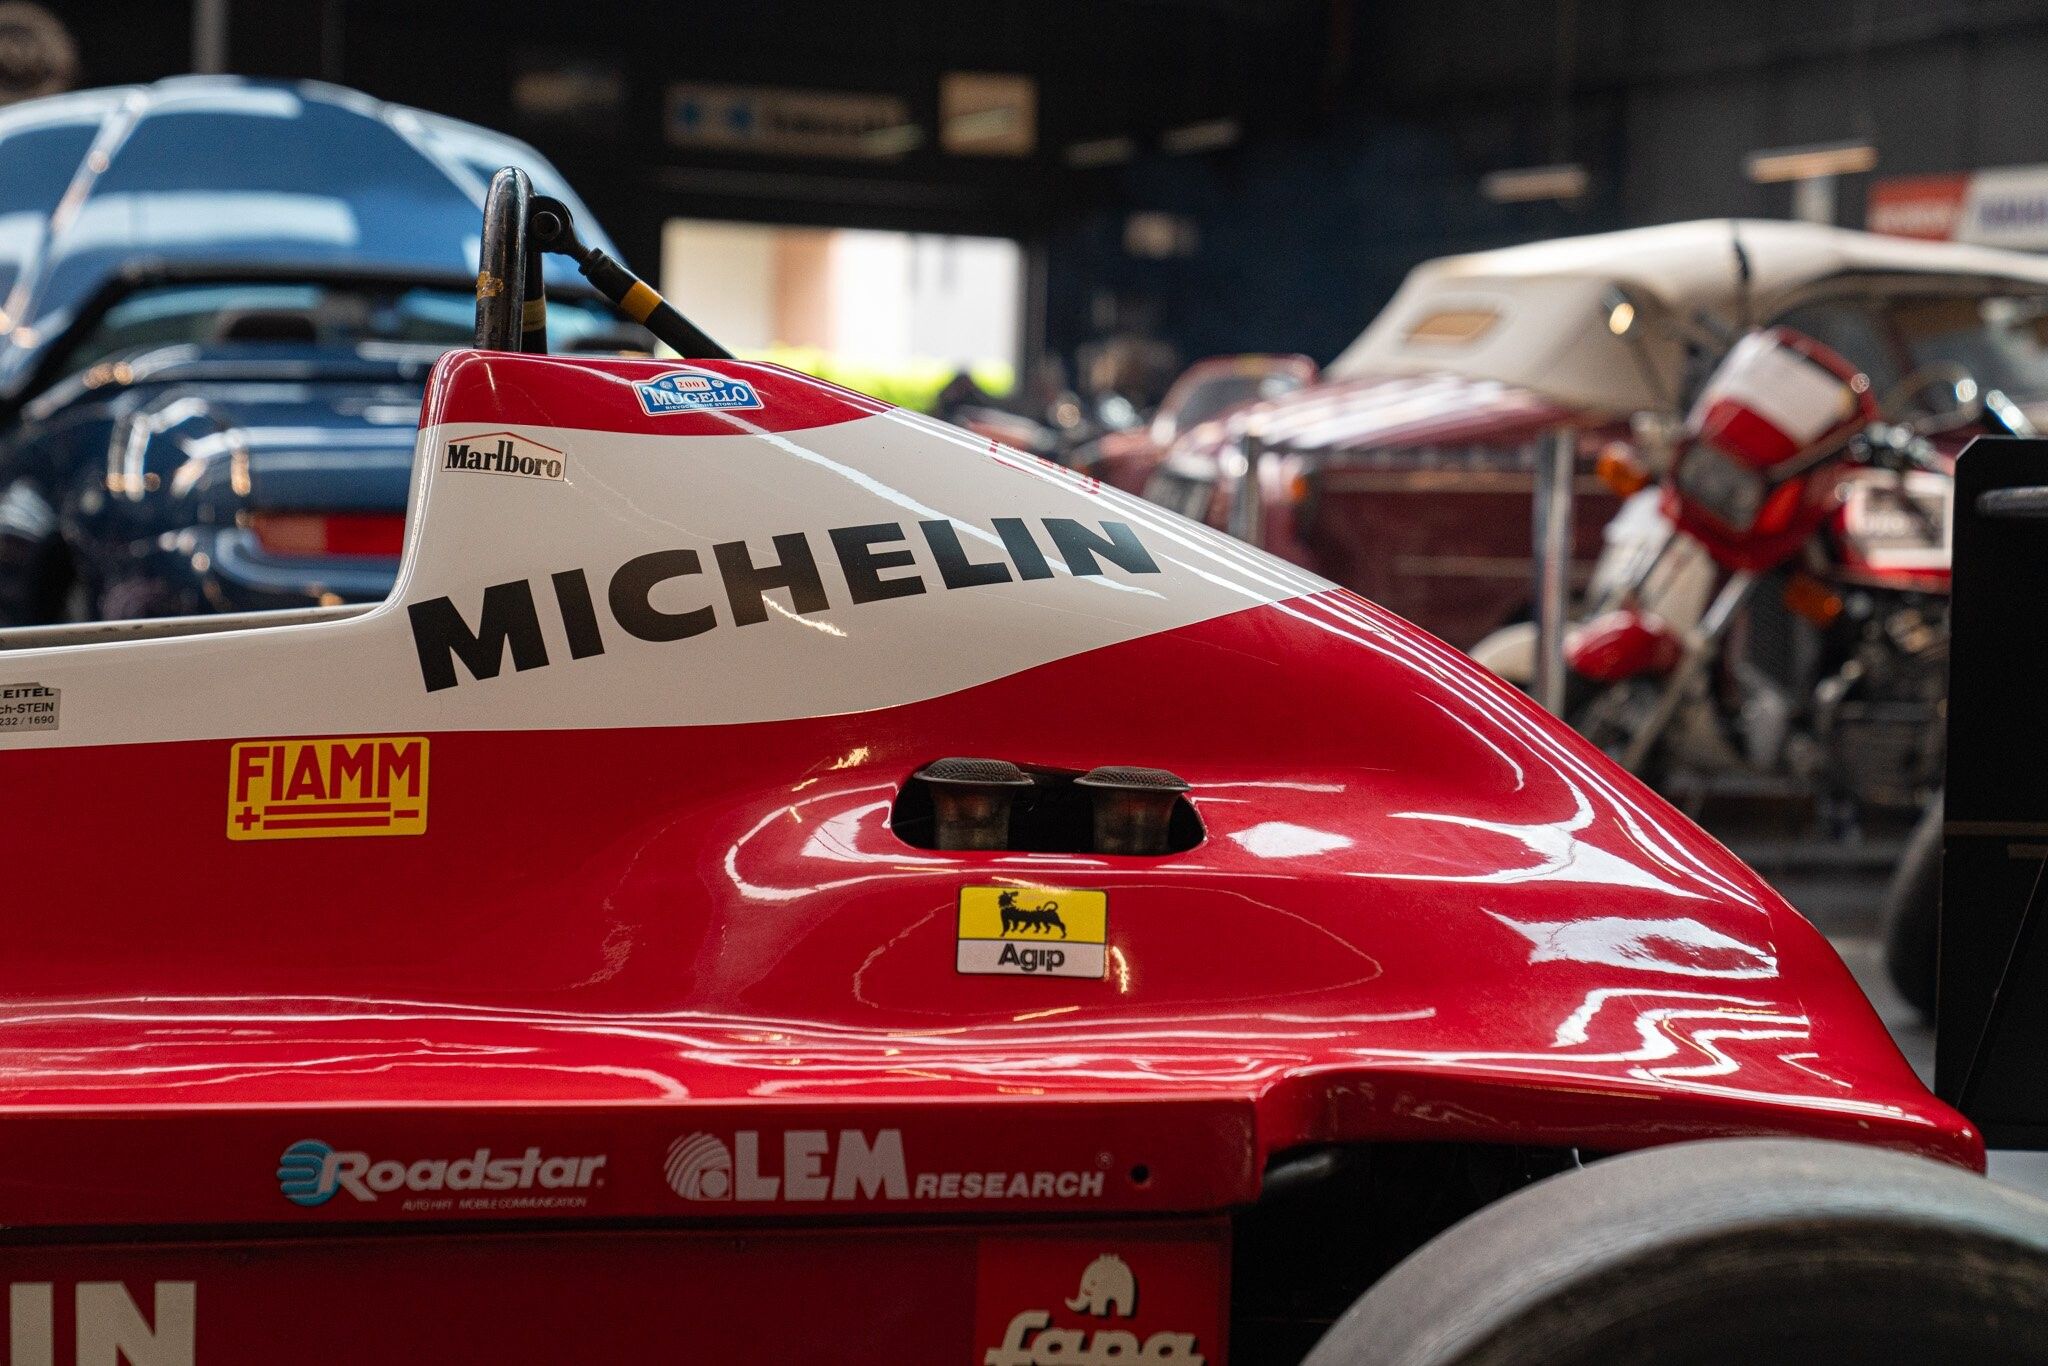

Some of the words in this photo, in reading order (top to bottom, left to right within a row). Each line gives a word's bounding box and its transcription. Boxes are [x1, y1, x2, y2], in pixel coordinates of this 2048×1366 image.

[642, 386, 749, 406] MUGELLO
[677, 380, 707, 389] 2001
[445, 440, 562, 478] Marlboro
[407, 517, 1161, 693] MICHELIN
[0, 687, 54, 698] EITEL
[28, 715, 54, 725] 1690
[236, 742, 422, 802] FIAMM
[998, 943, 1066, 972] Agip
[733, 1129, 910, 1201] LEM
[914, 1172, 1104, 1199] RESEARCH
